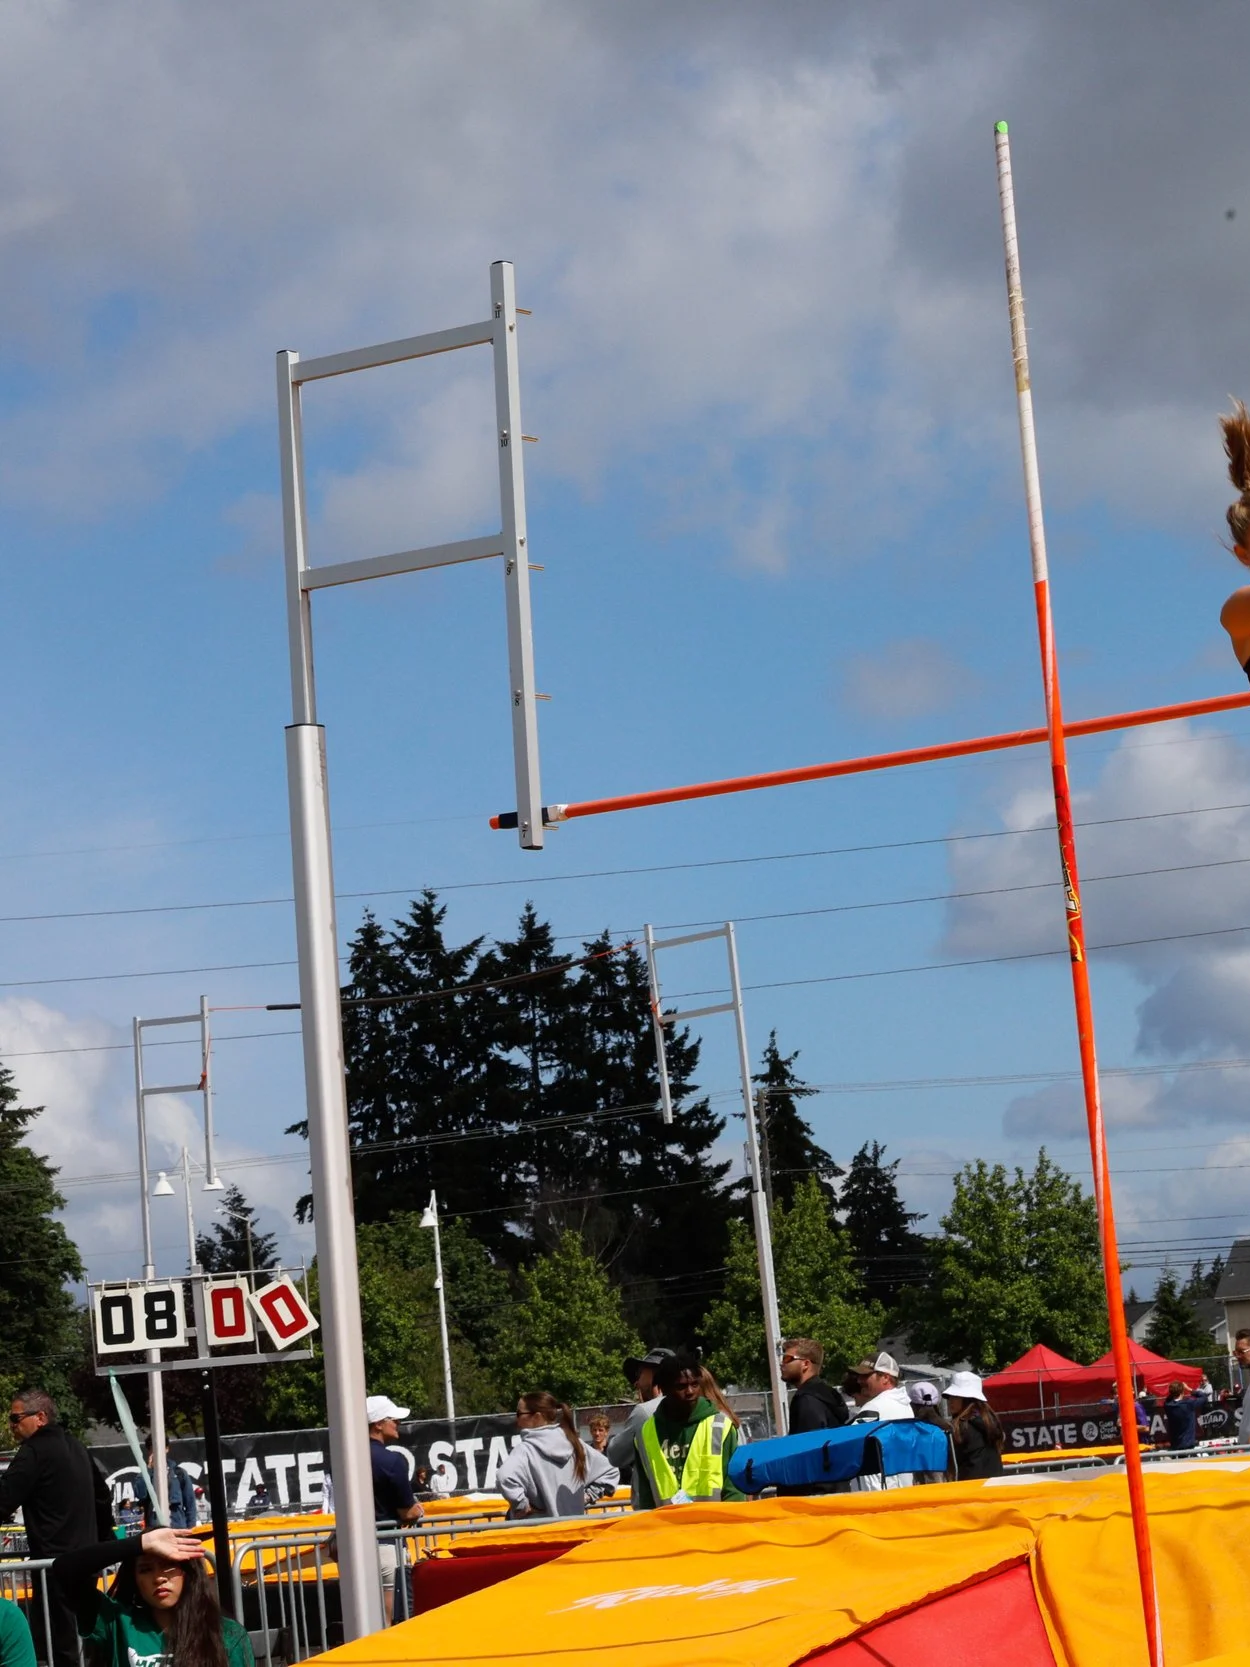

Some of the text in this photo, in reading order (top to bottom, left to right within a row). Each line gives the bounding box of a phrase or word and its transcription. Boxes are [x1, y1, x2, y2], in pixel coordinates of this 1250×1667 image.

[100, 1290, 178, 1346] 08
[1011, 1422, 1078, 1448] STATE
[428, 1434, 522, 1493] STA
